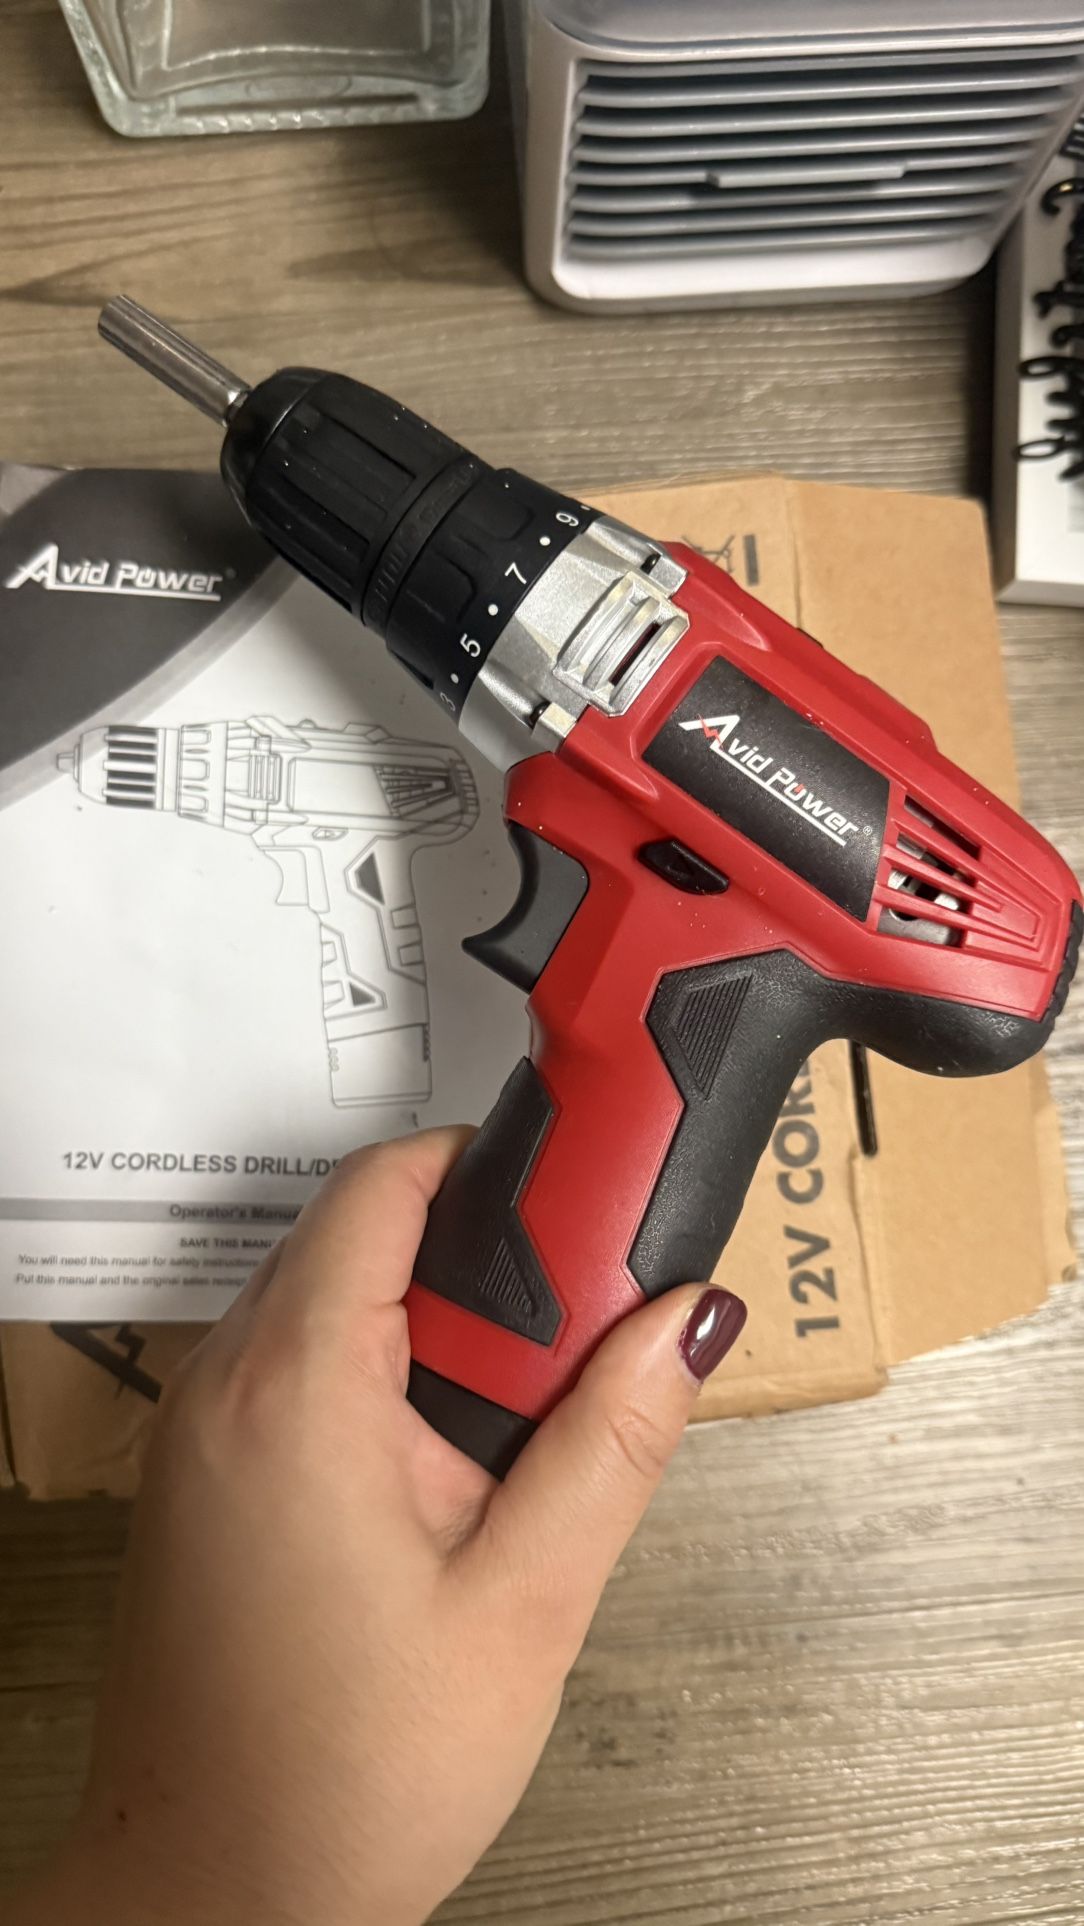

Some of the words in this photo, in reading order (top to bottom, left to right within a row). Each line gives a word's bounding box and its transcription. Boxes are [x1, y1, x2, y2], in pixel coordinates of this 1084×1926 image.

[6, 543, 109, 589] Avid
[116, 562, 223, 594] Power
[440, 692, 456, 712] 3
[459, 633, 481, 658] 5
[504, 562, 527, 584] 7
[555, 511, 579, 527] 9
[679, 714, 774, 774] Avid
[764, 767, 859, 836] Power
[772, 1059, 825, 1205] COR
[63, 1151, 104, 1170] 12V
[110, 1152, 238, 1174] CORDLESS
[244, 1156, 342, 1177] DRILL/D
[169, 1204, 247, 1220] Operator's
[19, 1254, 38, 1266] You
[40, 1255, 58, 1266] will
[60, 1256, 87, 1266] need
[89, 1255, 109, 1266] this
[111, 1256, 150, 1267] manual
[152, 1256, 167, 1267] for
[169, 1256, 199, 1269] safety
[180, 1237, 209, 1249] SAVE
[213, 1237, 239, 1249] THIS
[16, 1273, 34, 1284] Put
[36, 1274, 56, 1285] this
[58, 1275, 98, 1286] manual
[100, 1275, 121, 1286] and
[123, 1275, 140, 1286] the
[142, 1276, 179, 1288] original
[783, 1225, 841, 1338] 12V
